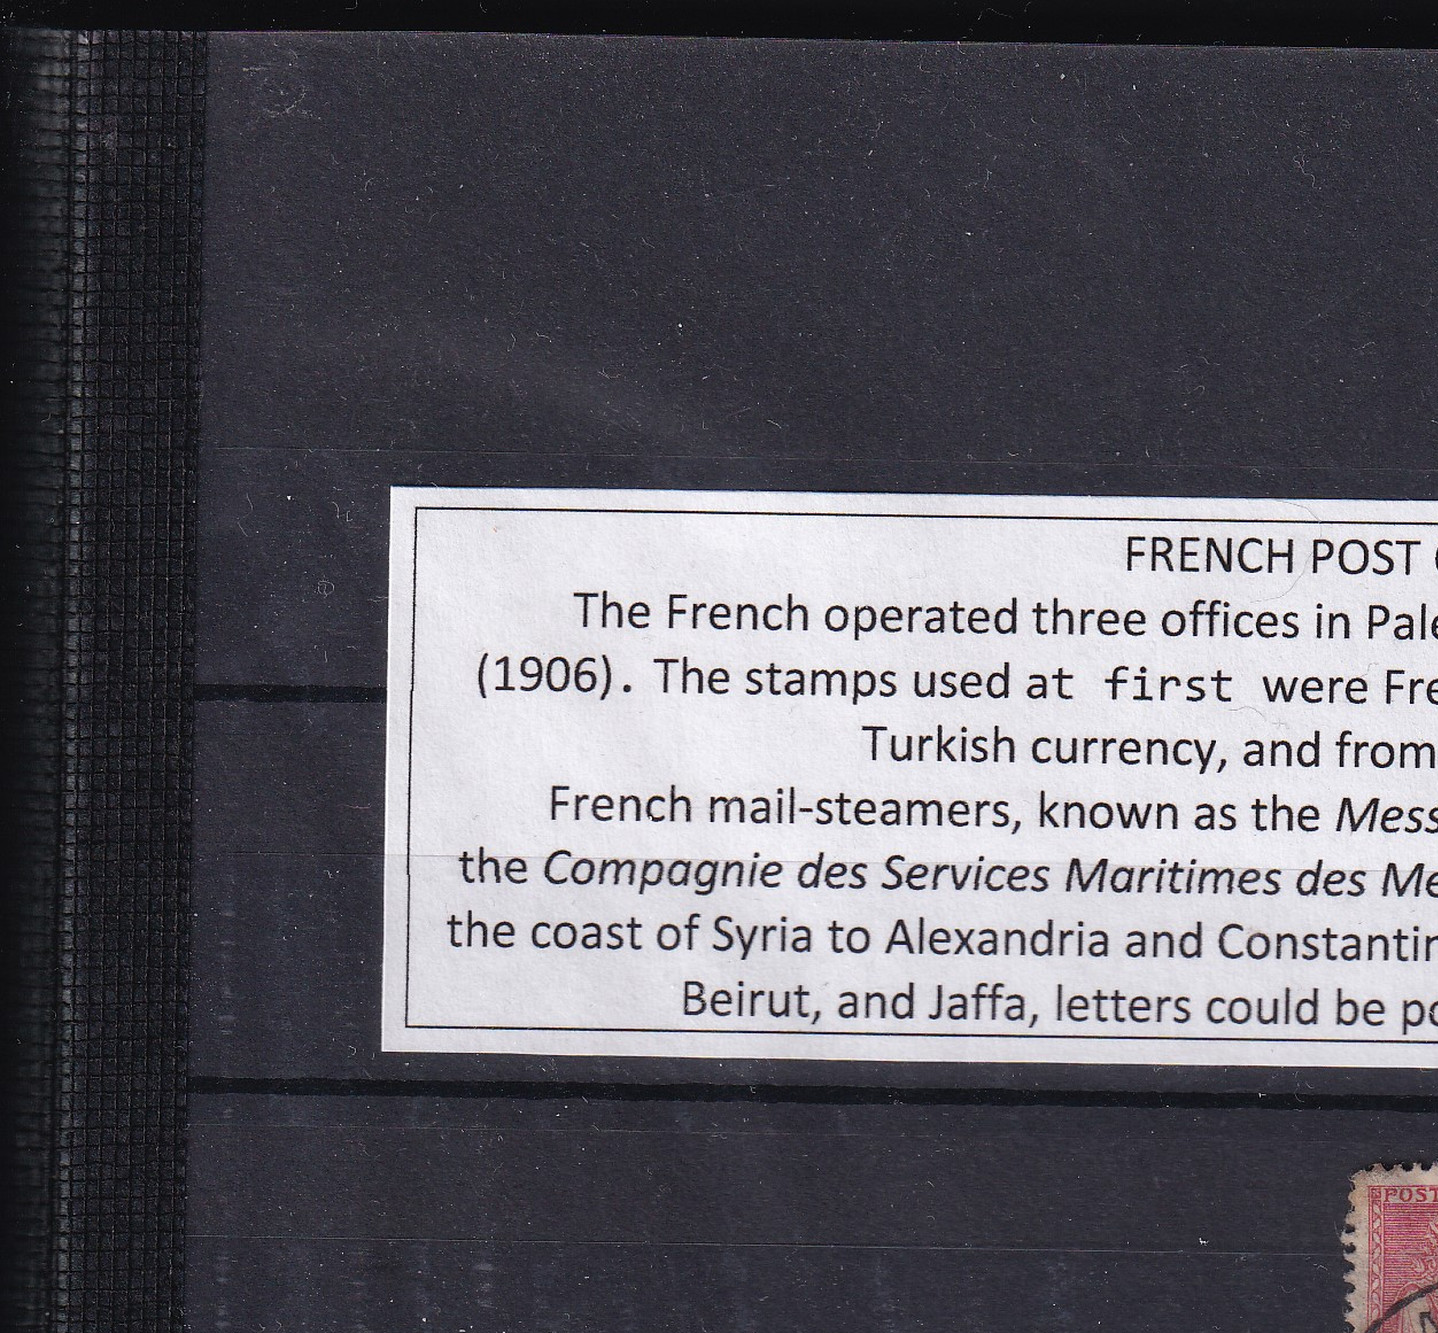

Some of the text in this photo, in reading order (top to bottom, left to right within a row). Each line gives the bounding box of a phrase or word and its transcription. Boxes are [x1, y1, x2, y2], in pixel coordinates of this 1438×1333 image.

[1126, 536, 1294, 574] FRENCH
[1312, 538, 1422, 576] POST
[573, 590, 651, 629] The
[668, 593, 809, 631] French
[824, 597, 1018, 641] operated
[1031, 597, 1146, 637] three
[1161, 599, 1300, 639] offices
[1316, 602, 1351, 639] in
[653, 656, 730, 695] The
[745, 662, 897, 706] stamps
[913, 661, 1010, 699] used
[1026, 667, 1074, 700] at
[1104, 665, 1233, 703] first
[1262, 675, 1368, 705] were
[861, 724, 1015, 763] Turkish
[1031, 736, 1227, 775] currency,
[1243, 730, 1321, 768] and
[1335, 730, 1436, 769] from
[551, 784, 692, 823] French
[709, 786, 1021, 835] mail-steamers,
[1039, 790, 1178, 830] known
[1194, 803, 1237, 831] as
[1250, 793, 1320, 833] the
[458, 846, 528, 885] the
[543, 849, 783, 896] Compagnie
[797, 851, 868, 890] des
[881, 854, 1051, 893] Services
[1065, 857, 1282, 896] Maritimes
[1295, 859, 1367, 897] des
[446, 909, 516, 949] the
[531, 916, 643, 951] coast
[656, 912, 701, 951] of
[712, 915, 812, 961] Syria
[827, 920, 871, 954] to
[885, 916, 1109, 958] Alexandria
[1125, 921, 1203, 959] and
[683, 980, 821, 1025] Beirut,
[838, 982, 915, 1020] and
[928, 982, 1038, 1028] Jaffa,
[1056, 983, 1191, 1024] letters
[1206, 987, 1319, 1026] could
[1336, 987, 1386, 1027] be
